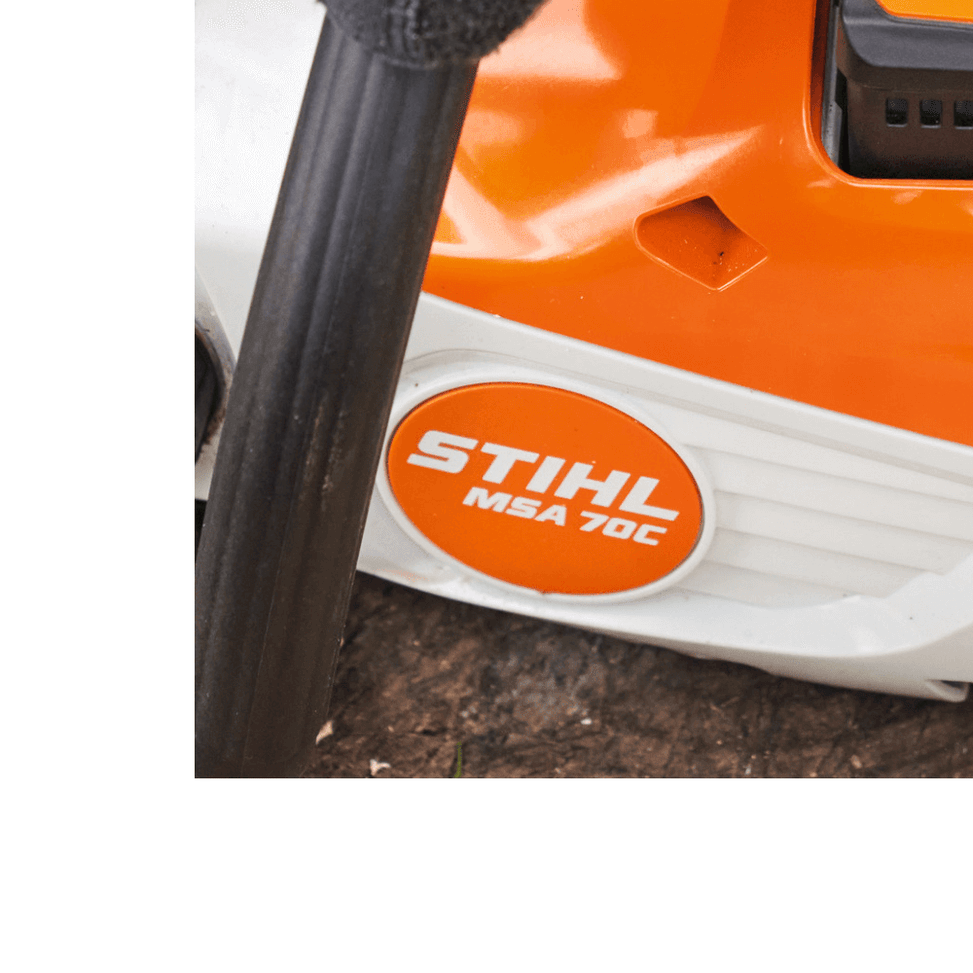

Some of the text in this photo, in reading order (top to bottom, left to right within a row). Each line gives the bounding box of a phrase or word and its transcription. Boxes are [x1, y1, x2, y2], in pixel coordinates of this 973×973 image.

[407, 430, 679, 521] STIHL
[462, 486, 667, 546] MSA 70C
